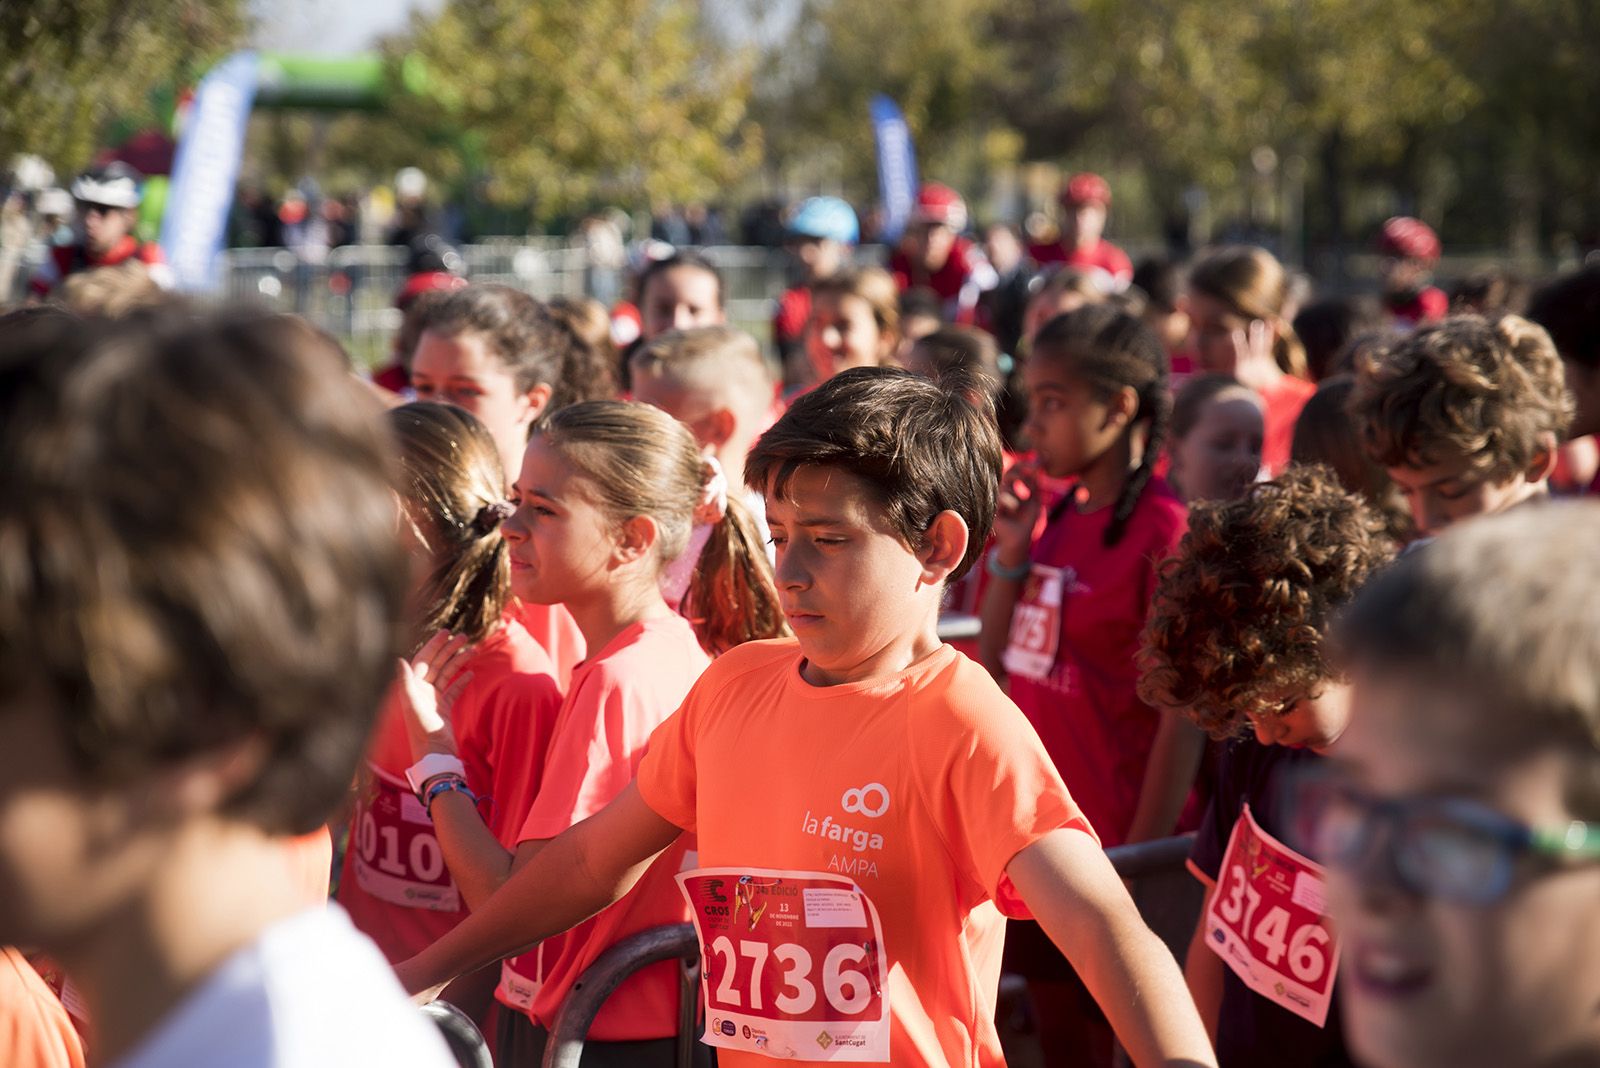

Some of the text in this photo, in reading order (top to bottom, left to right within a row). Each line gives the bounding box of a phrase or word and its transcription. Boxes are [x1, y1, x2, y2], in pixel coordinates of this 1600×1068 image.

[827, 854, 878, 878] AMPA
[704, 905, 730, 916] CROS
[780, 903, 789, 913] 13
[1220, 865, 1330, 983] 3746
[712, 936, 871, 1014] 2736
